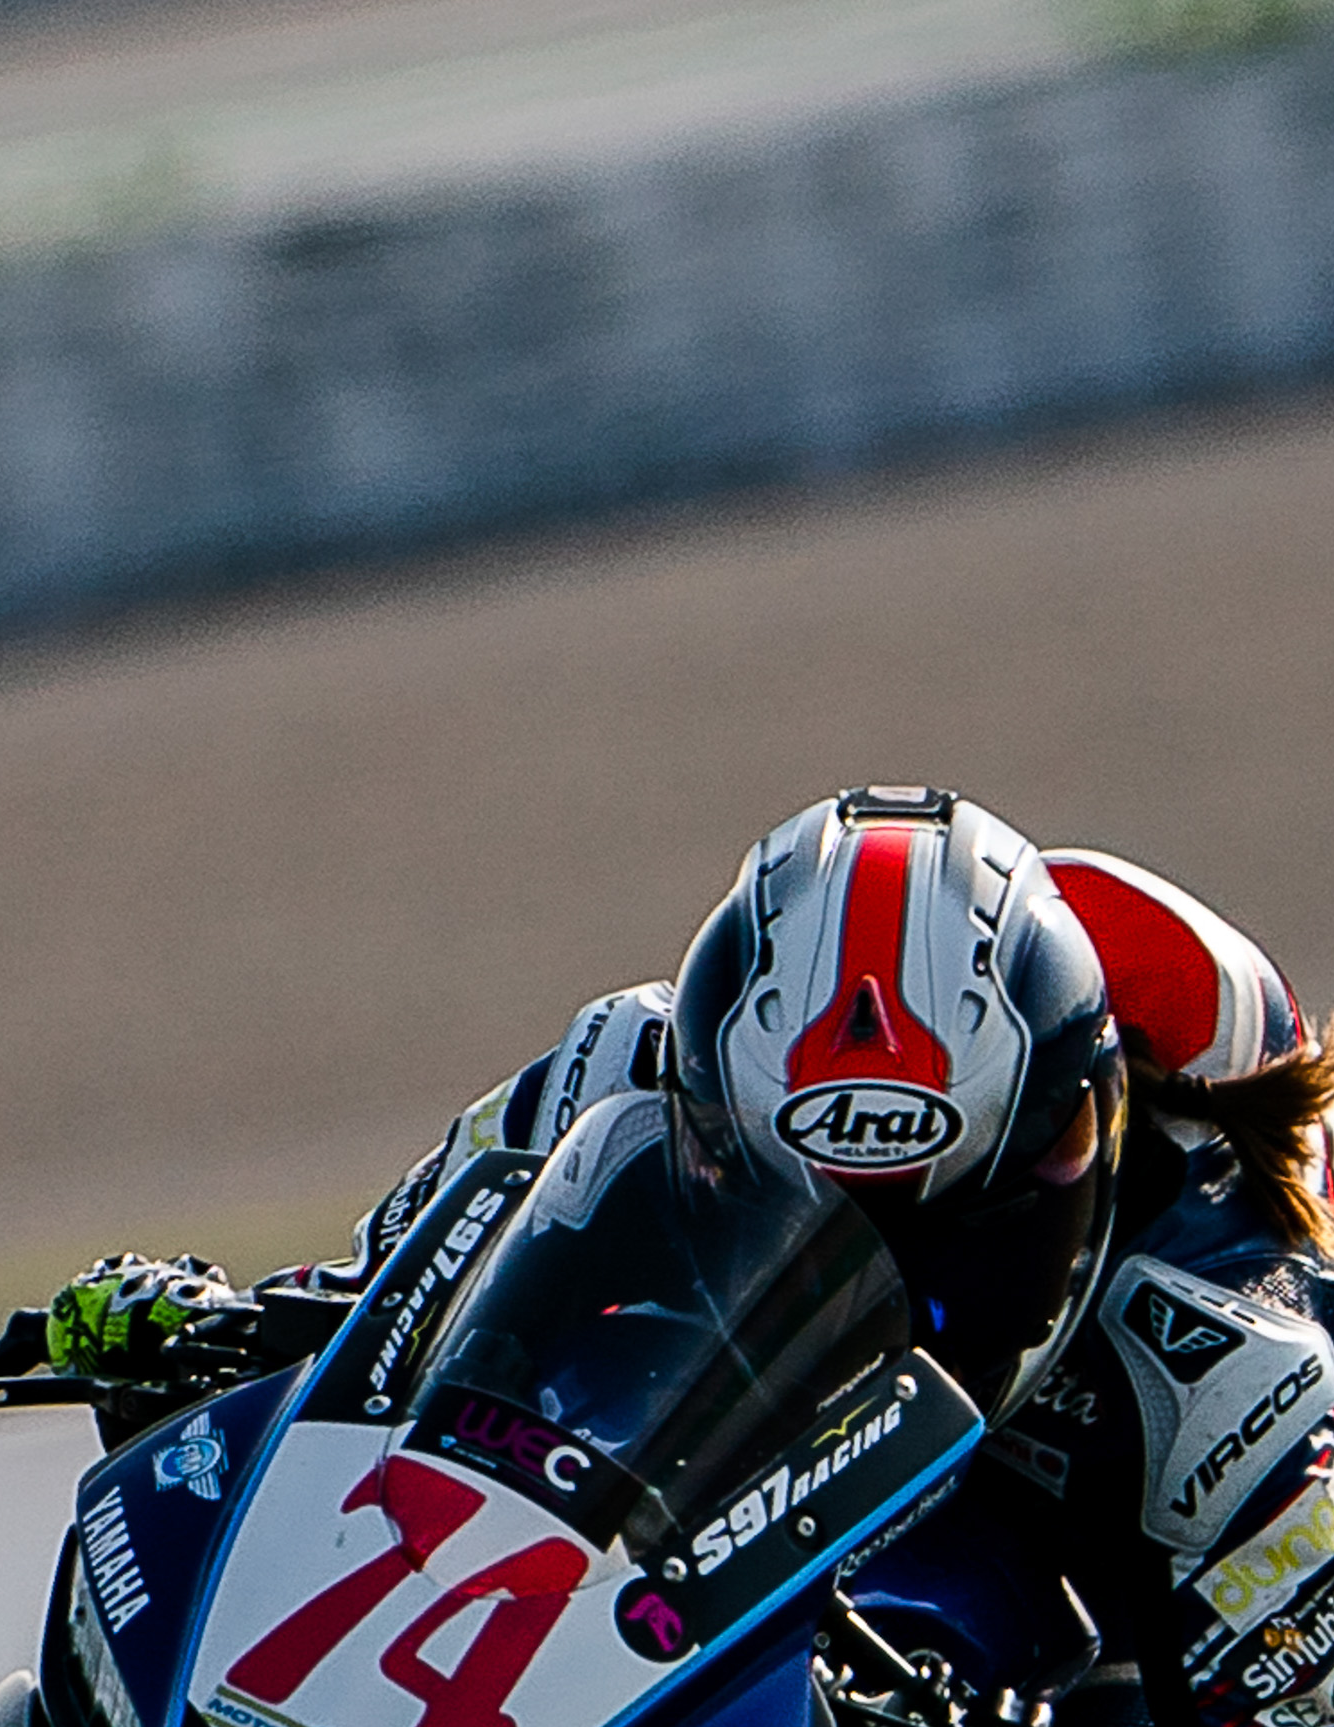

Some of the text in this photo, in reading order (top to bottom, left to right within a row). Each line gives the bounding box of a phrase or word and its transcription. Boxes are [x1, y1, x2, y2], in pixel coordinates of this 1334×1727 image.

[551, 995, 624, 1156] VIRCO
[789, 1092, 941, 1144] Arai
[1169, 1353, 1323, 1519] VIRCOS
[82, 1485, 151, 1635] YAMAHA
